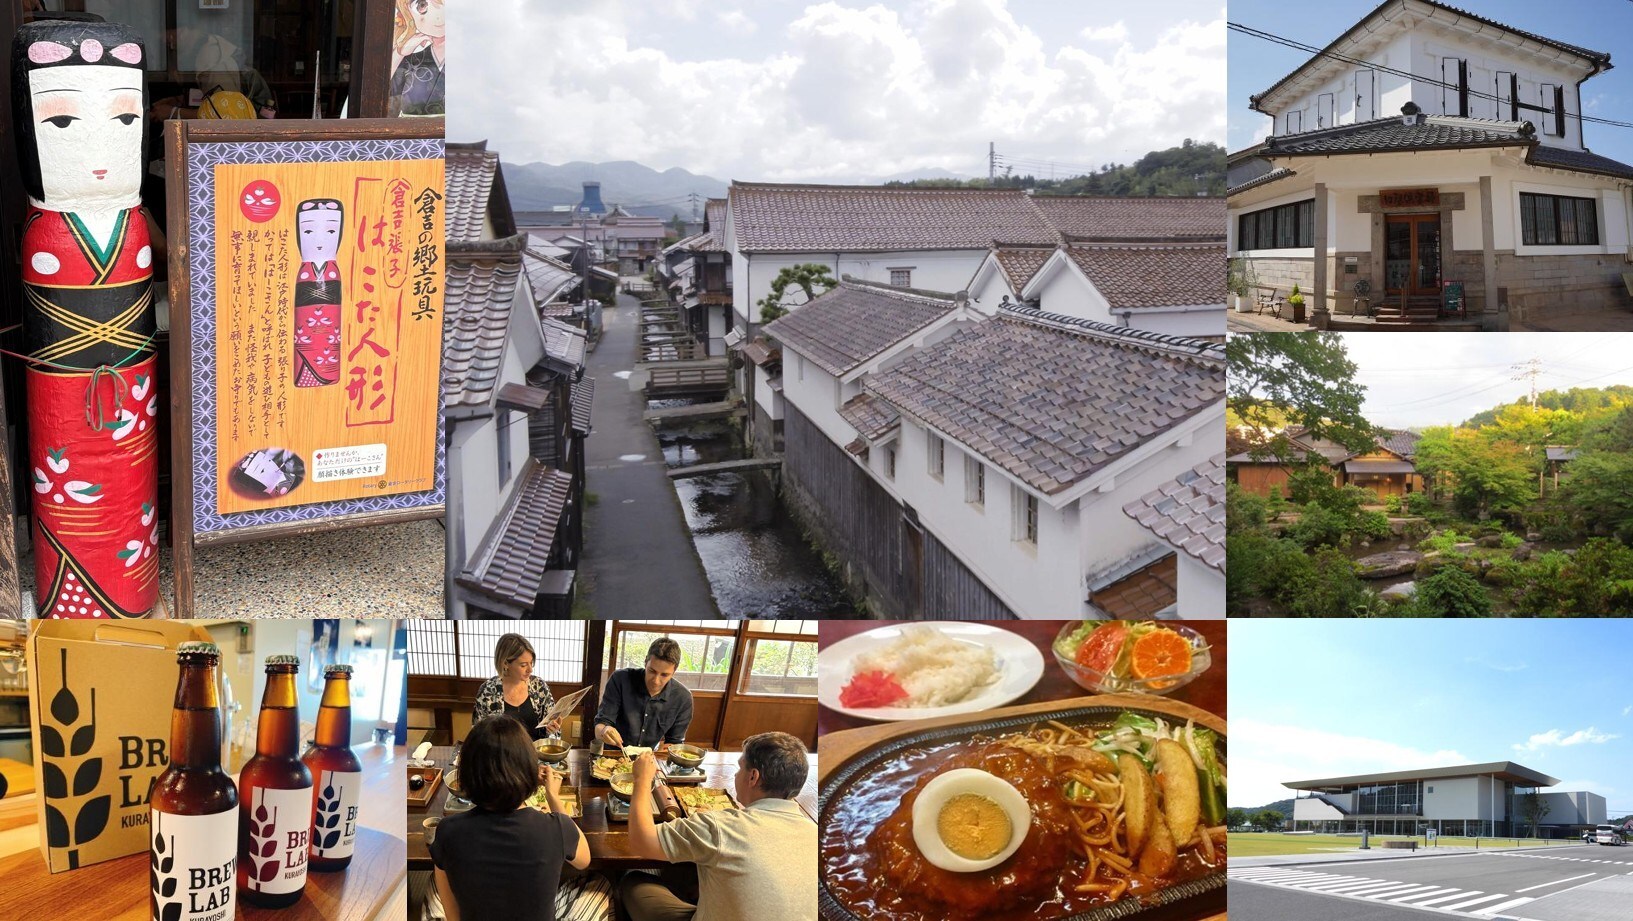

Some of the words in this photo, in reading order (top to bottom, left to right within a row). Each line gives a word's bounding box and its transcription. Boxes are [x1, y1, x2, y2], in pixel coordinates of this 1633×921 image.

[412, 187, 442, 321] 倉吉の郷土玩具
[345, 215, 390, 411] はこた人形
[317, 465, 380, 478] 顔描き体験できます
[286, 828, 311, 849] BR
[188, 886, 230, 914] LAB
[189, 909, 226, 921] AYOSHI
